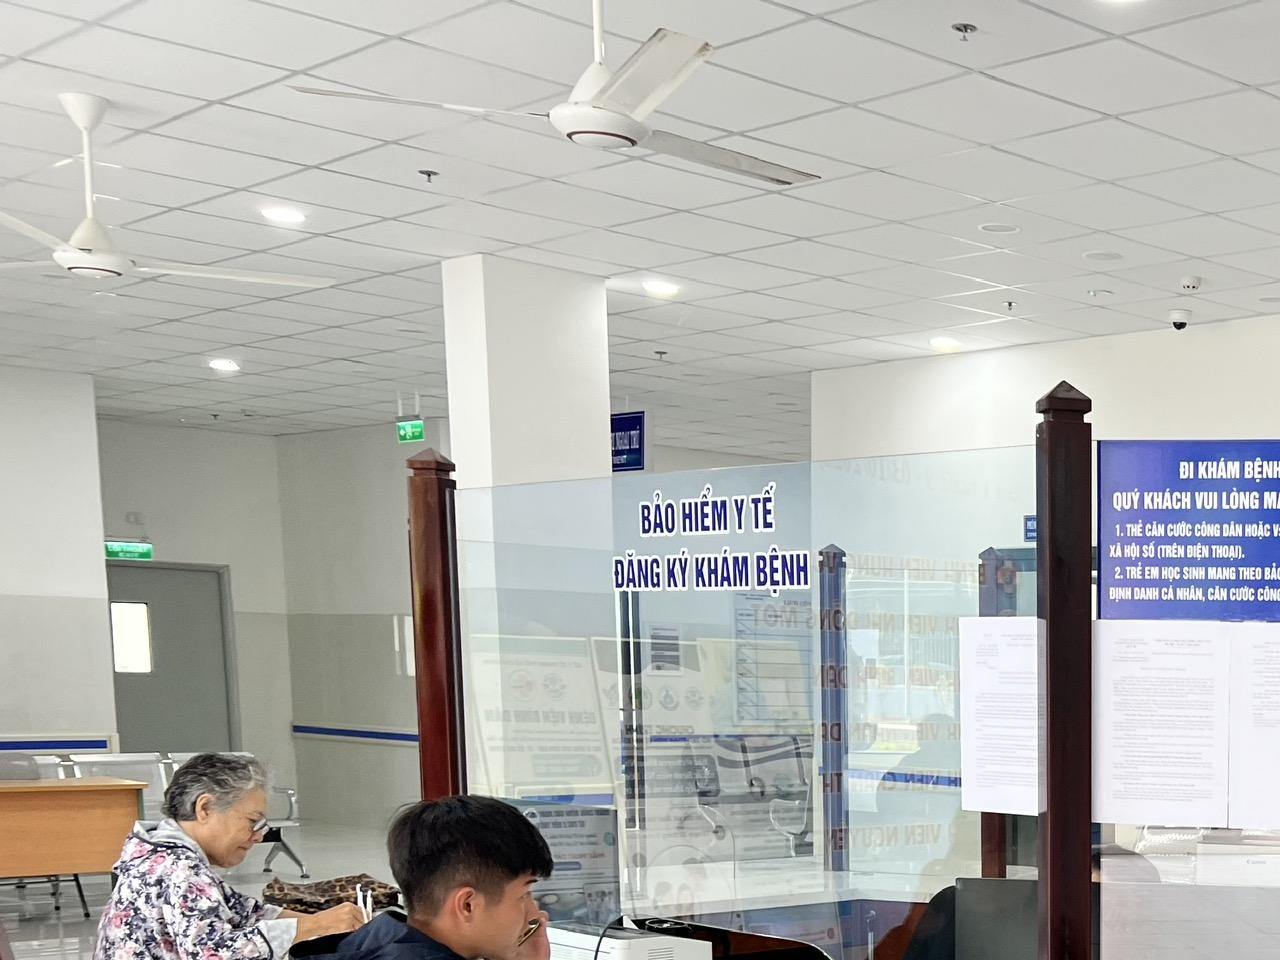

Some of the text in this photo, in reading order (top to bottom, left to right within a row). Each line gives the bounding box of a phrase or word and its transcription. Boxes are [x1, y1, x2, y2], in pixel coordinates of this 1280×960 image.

[1179, 461, 1194, 479] ĐI
[1197, 457, 1240, 479] KHÁM
[641, 485, 774, 534] BẢO HIỂM Y TẾ
[1112, 488, 1139, 511] QUÝ
[1144, 487, 1191, 510] KHÁCH
[1195, 491, 1218, 510] VUI
[1221, 487, 1260, 510] LÒNG
[1115, 523, 1124, 537] 1.
[1126, 519, 1143, 537] THẺ
[1145, 520, 1165, 537] CĂN
[1167, 520, 1192, 537] CƯỚC
[1194, 520, 1220, 537] CÔNG
[1222, 520, 1243, 537] DÂN
[1245, 520, 1271, 540] HOẶC
[1109, 541, 1245, 561] XÃ HỘI SỐ (TRÊN ĐIỆN THOẠI).
[613, 547, 809, 594] ĐĂNG KÝ KHÁM BỆNH
[1114, 566, 1124, 579] 2.
[1125, 562, 1143, 579] TRẺ
[1145, 566, 1159, 579] EM
[1161, 566, 1180, 582] HỌC
[1182, 566, 1205, 580] SINH
[1207, 566, 1236, 580] MANG
[1238, 567, 1262, 580] THEO
[1109, 586, 1132, 602] ĐỊNH
[1134, 587, 1159, 600] DANH
[1161, 584, 1174, 600] CÁ
[1176, 584, 1205, 602] NHÂN,
[1207, 585, 1227, 601] CĂN
[1229, 585, 1255, 601] CƯỚC
